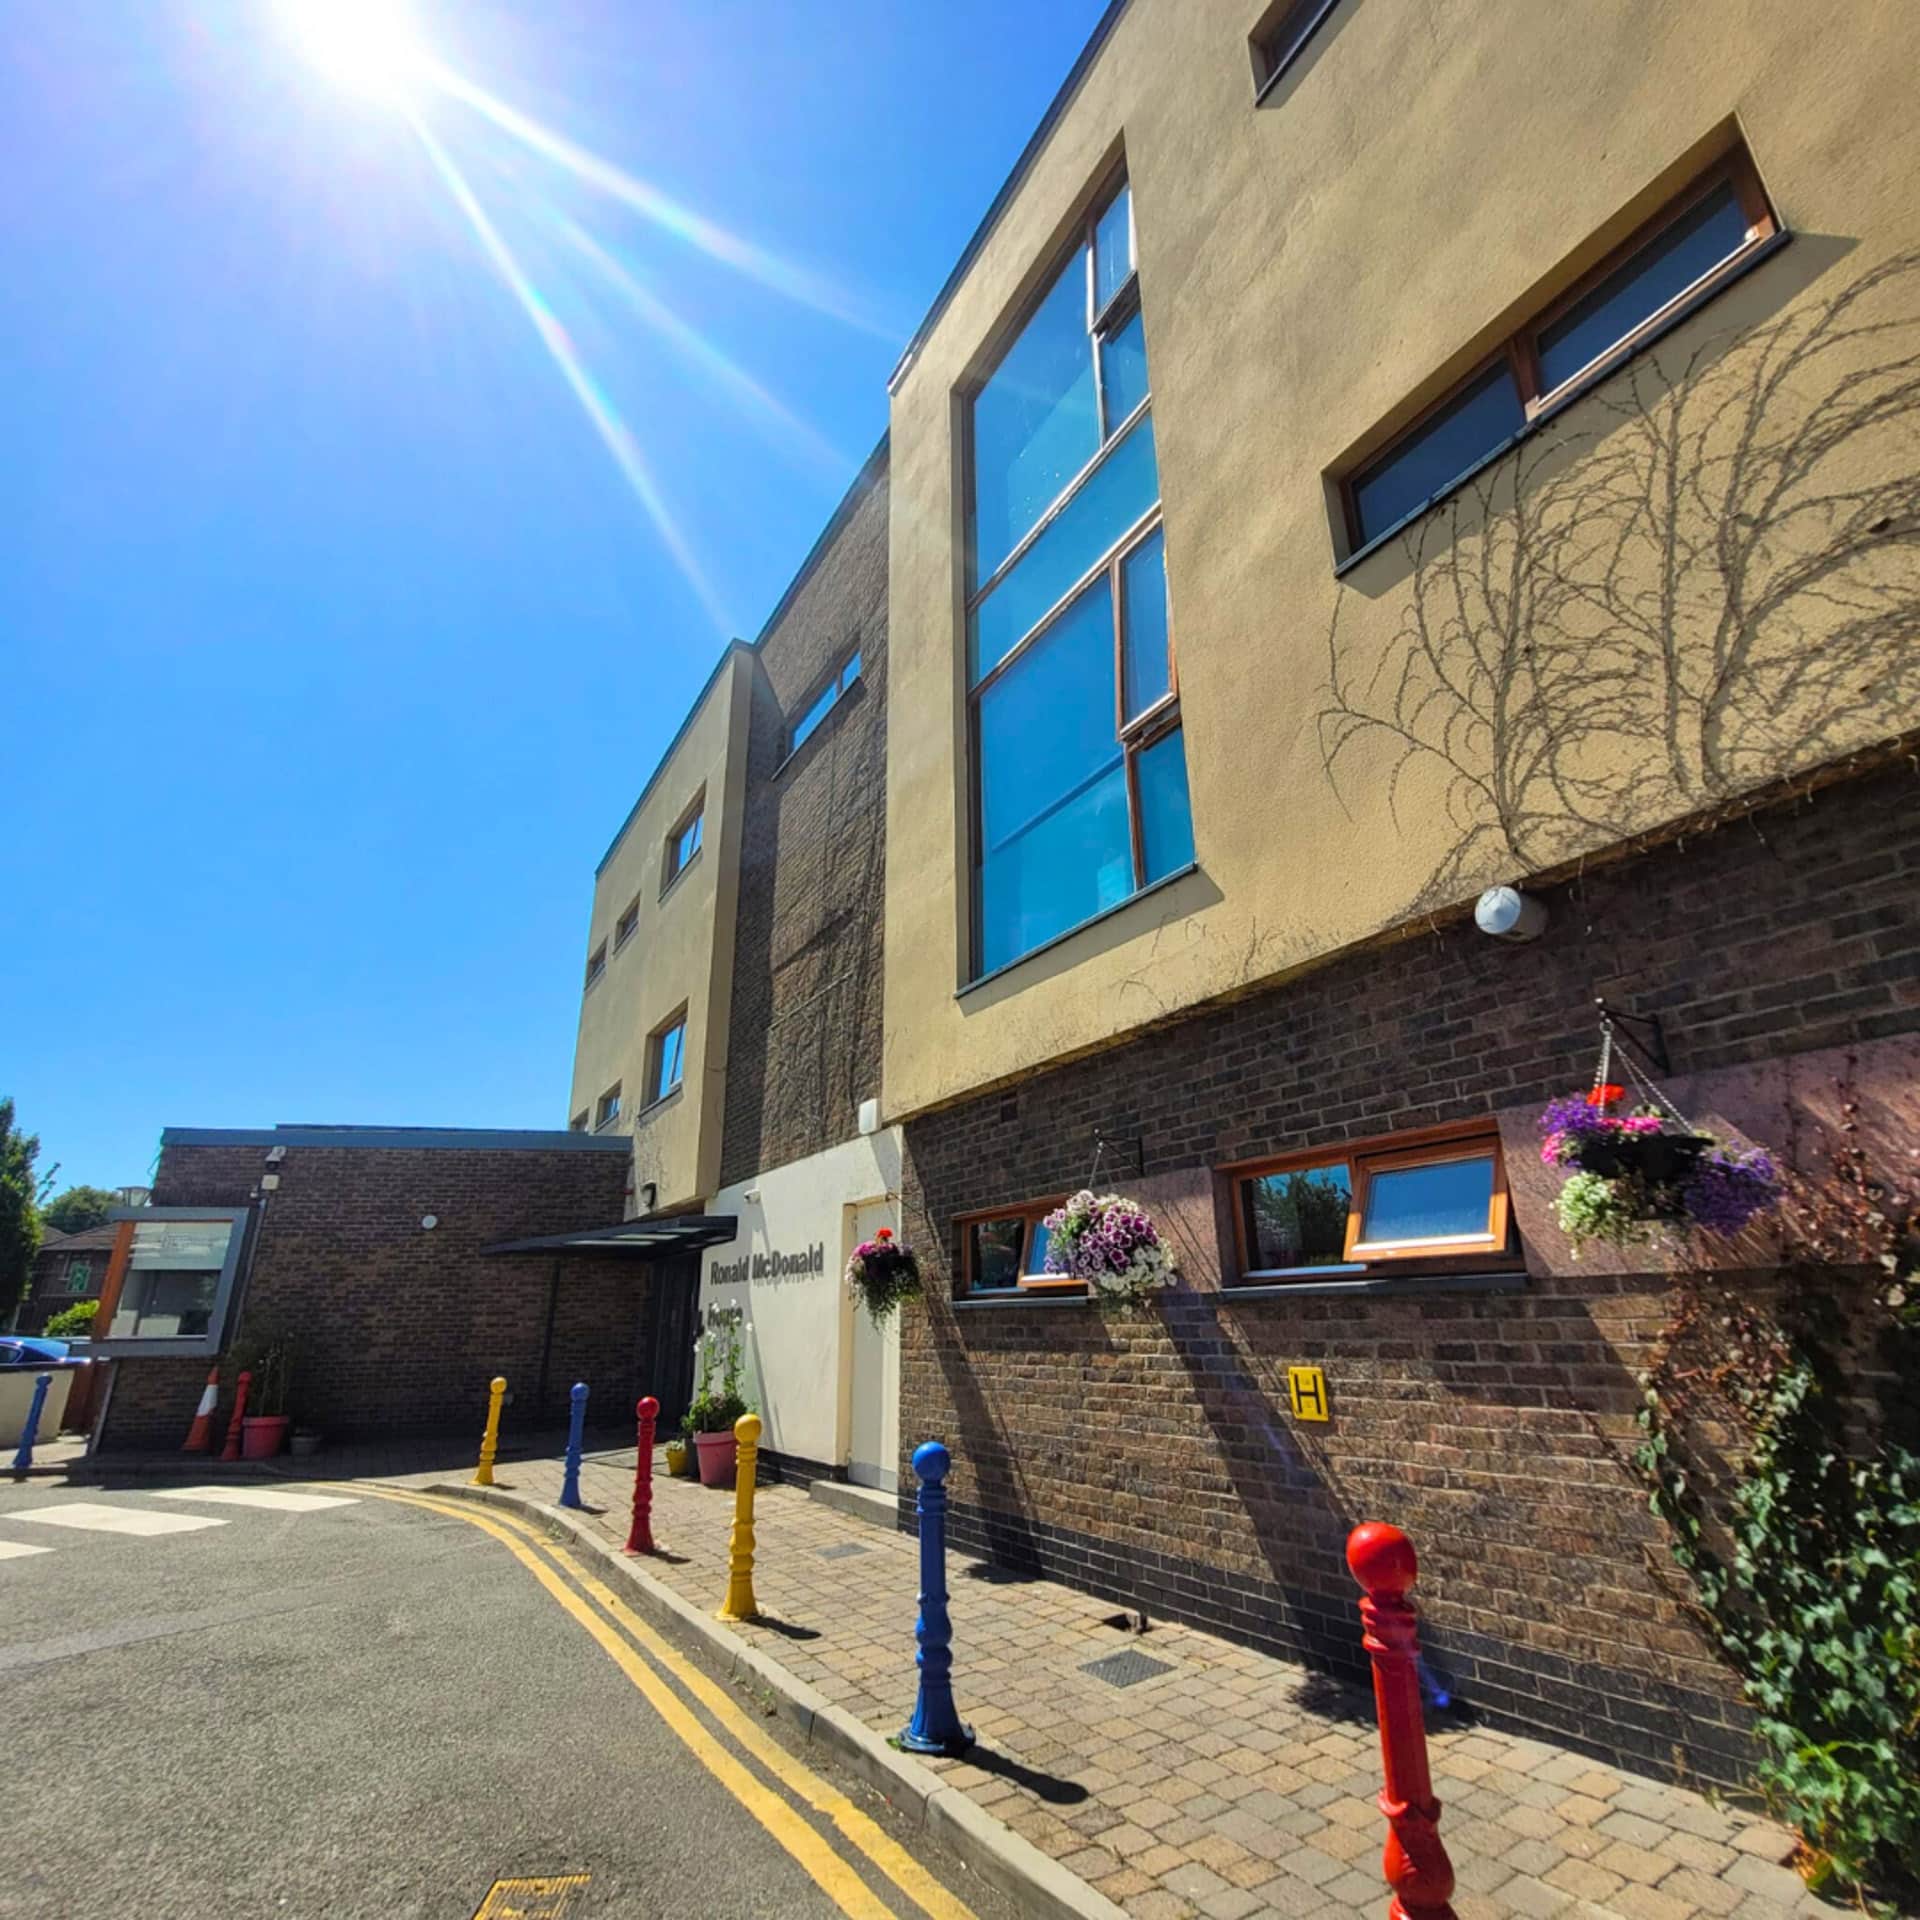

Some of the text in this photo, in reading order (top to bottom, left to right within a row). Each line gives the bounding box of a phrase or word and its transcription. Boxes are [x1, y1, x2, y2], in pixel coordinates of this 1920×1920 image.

[710, 1241, 823, 1285] Ronald McDonald
[1294, 1374, 1321, 1415] H
